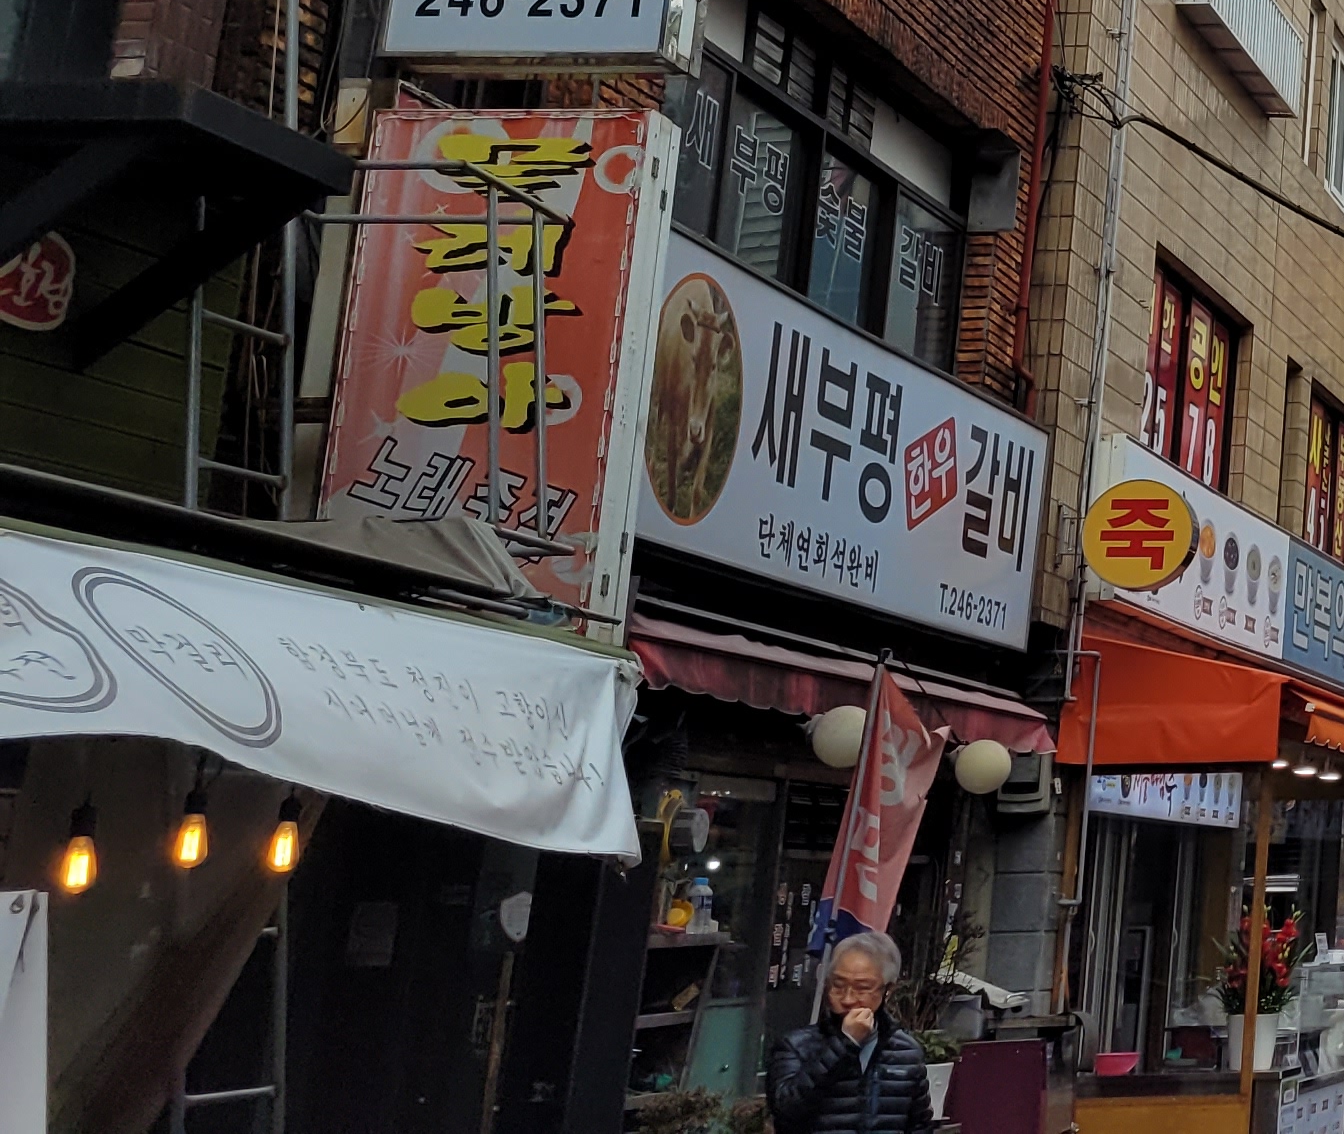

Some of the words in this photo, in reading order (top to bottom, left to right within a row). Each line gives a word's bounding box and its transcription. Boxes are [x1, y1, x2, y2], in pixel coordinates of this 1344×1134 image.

[816, 184, 867, 262] 숯불
[900, 225, 943, 306] 갈비
[1190, 314, 1225, 406] 공인
[752, 321, 903, 525] 새부평
[907, 429, 956, 520] 한우
[962, 424, 1034, 572] 갈비
[757, 513, 879, 593] 단체연회석완비
[1100, 499, 1174, 571] 죽
[939, 583, 1007, 630] T.246-2371
